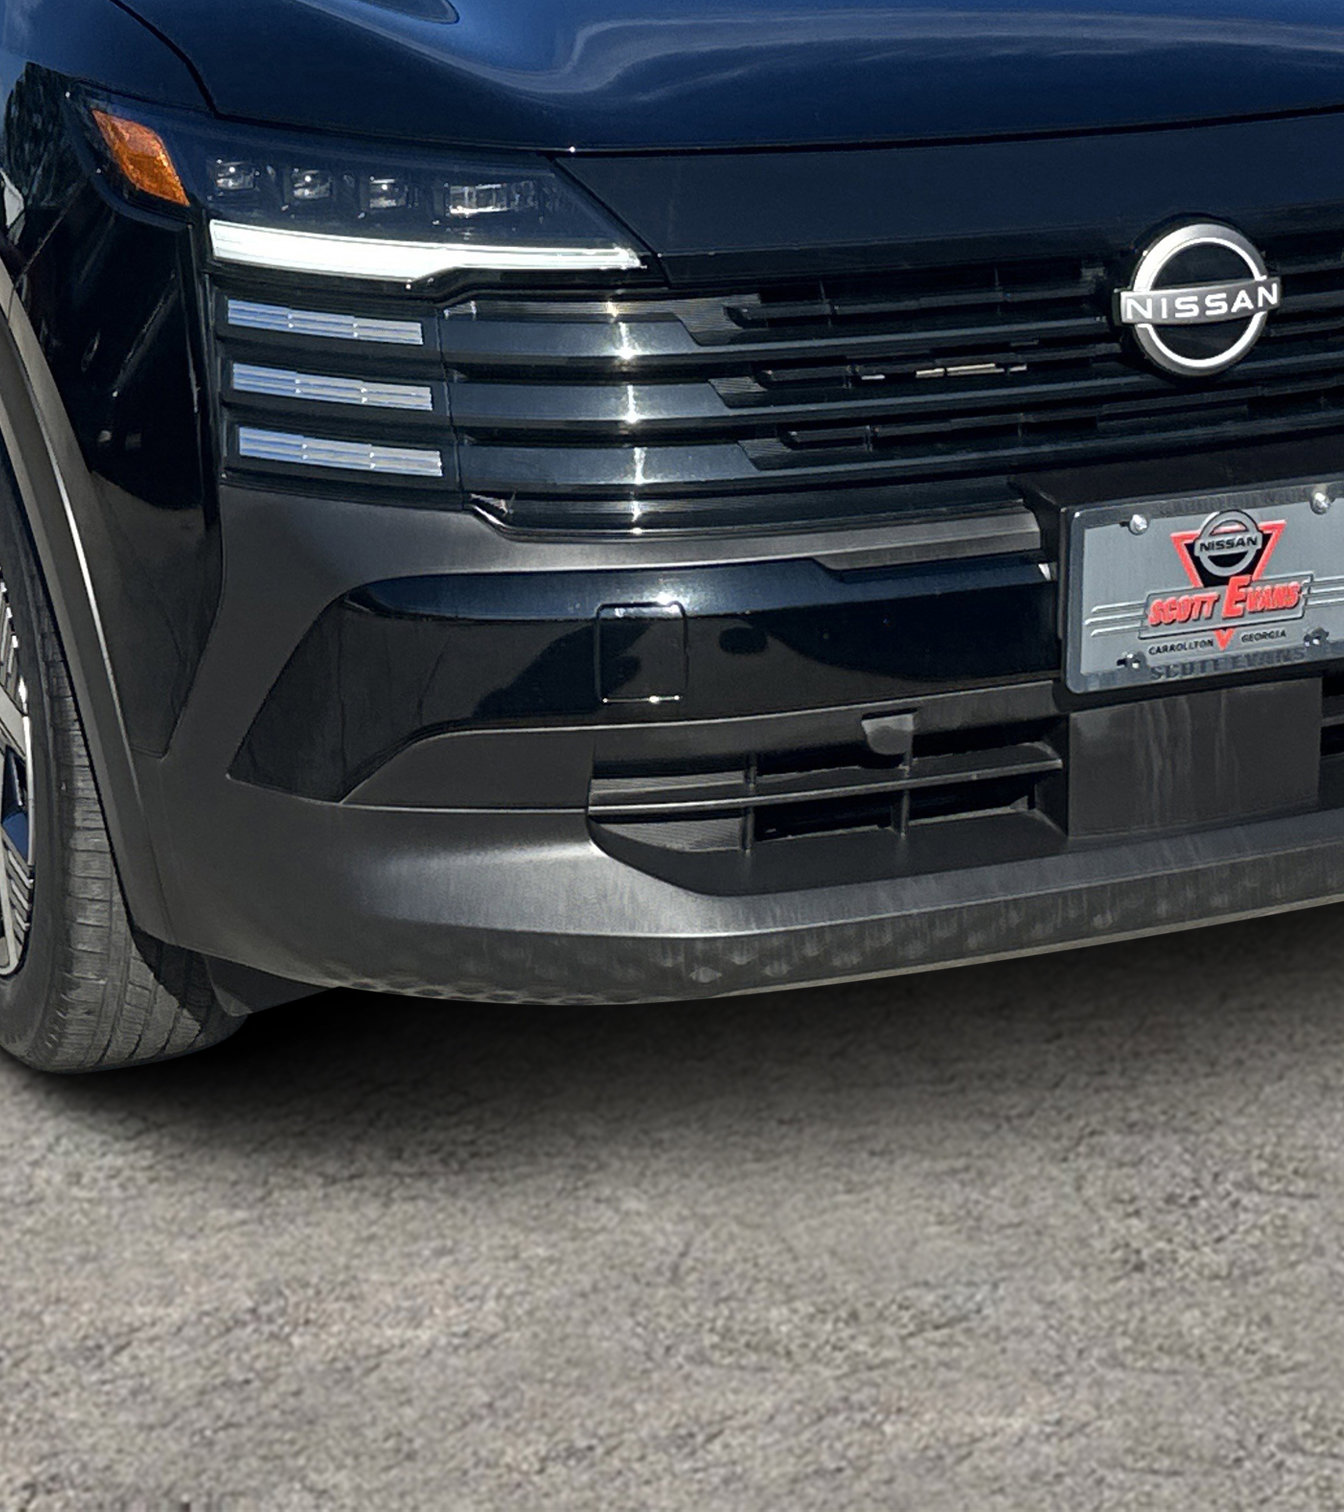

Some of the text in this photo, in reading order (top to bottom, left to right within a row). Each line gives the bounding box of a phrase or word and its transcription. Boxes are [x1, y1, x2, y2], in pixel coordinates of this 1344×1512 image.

[1126, 283, 1278, 320] NISSAN
[1199, 535, 1258, 552] NISSAN
[1148, 592, 1220, 626] SCOTT
[1148, 629, 1287, 656] CARROLLTON GEORGIA
